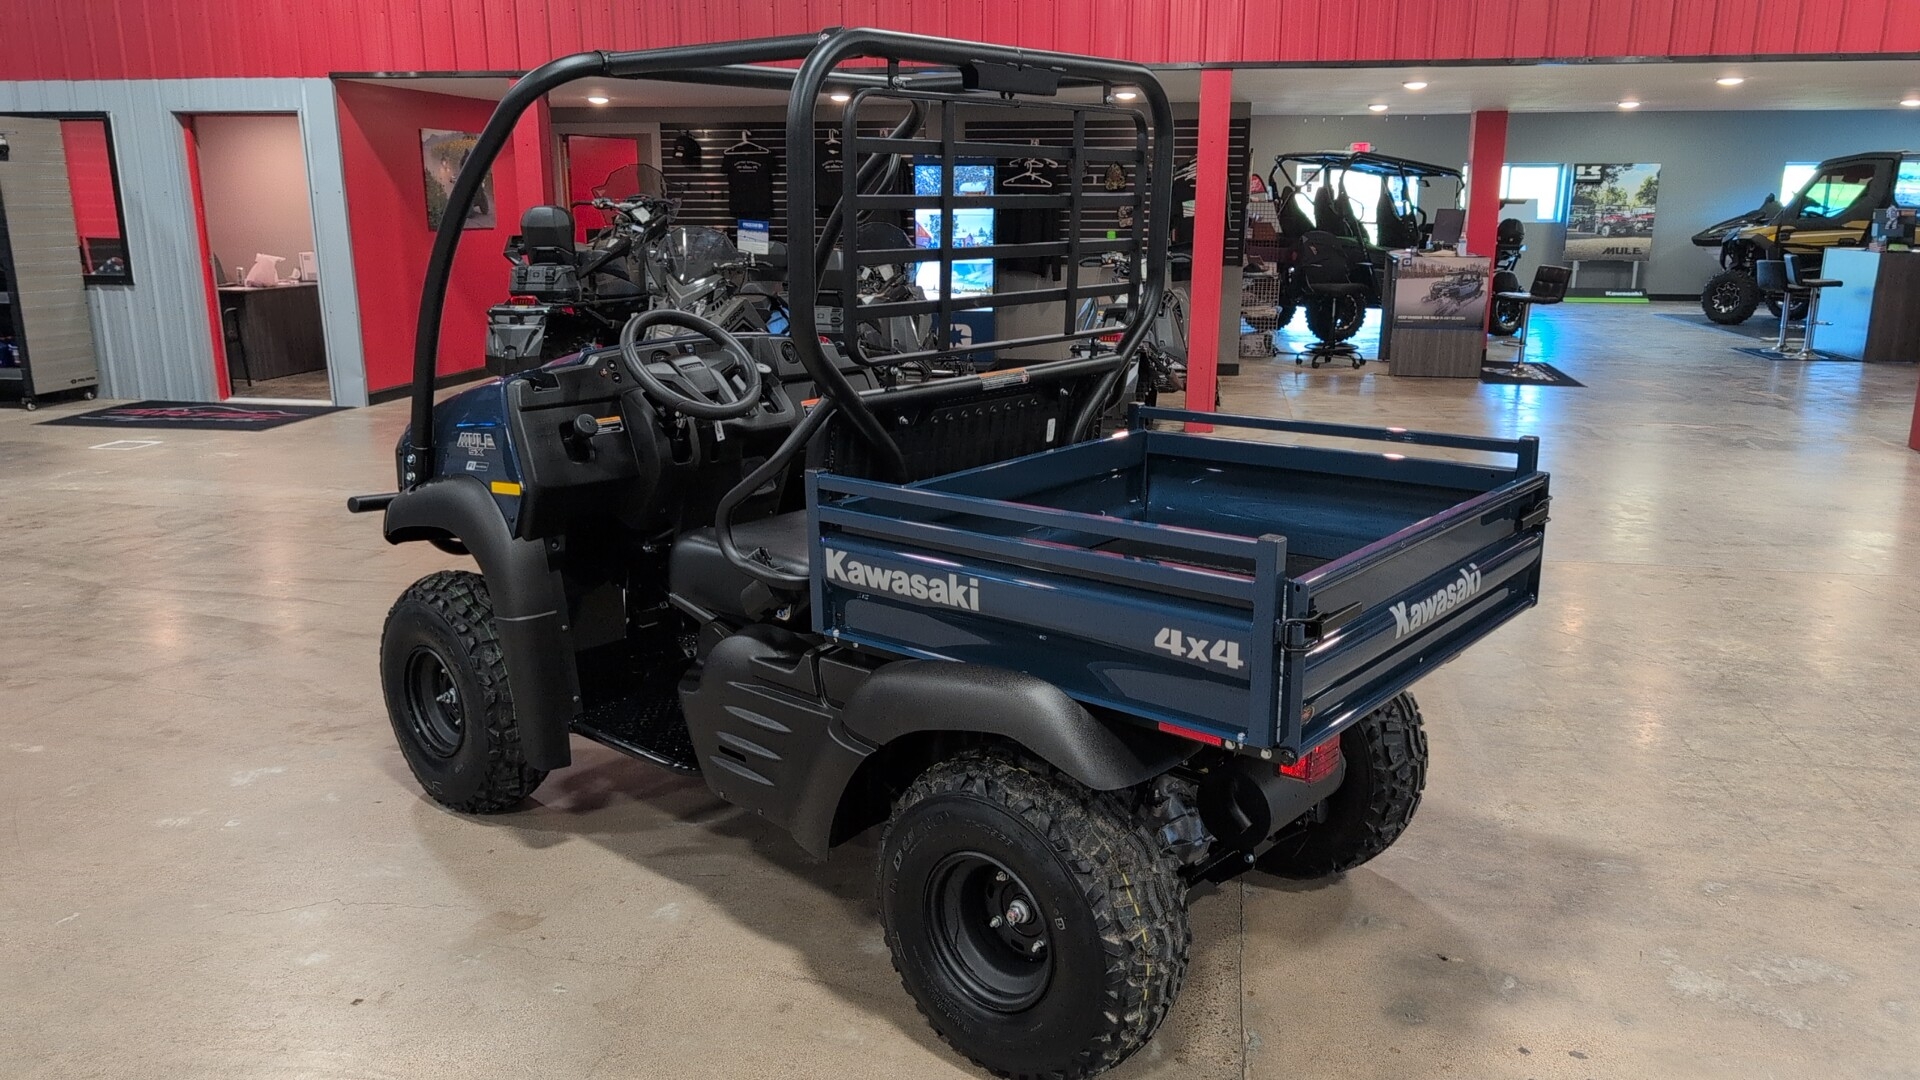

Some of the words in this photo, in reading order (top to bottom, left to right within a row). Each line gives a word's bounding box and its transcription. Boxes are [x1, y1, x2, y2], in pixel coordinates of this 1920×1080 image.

[1601, 247, 1643, 255] MULE
[457, 432, 497, 449] MULE
[825, 548, 980, 612] Kawasaki
[1389, 563, 1482, 639] Kawasaki
[1154, 627, 1244, 670] 4x4
